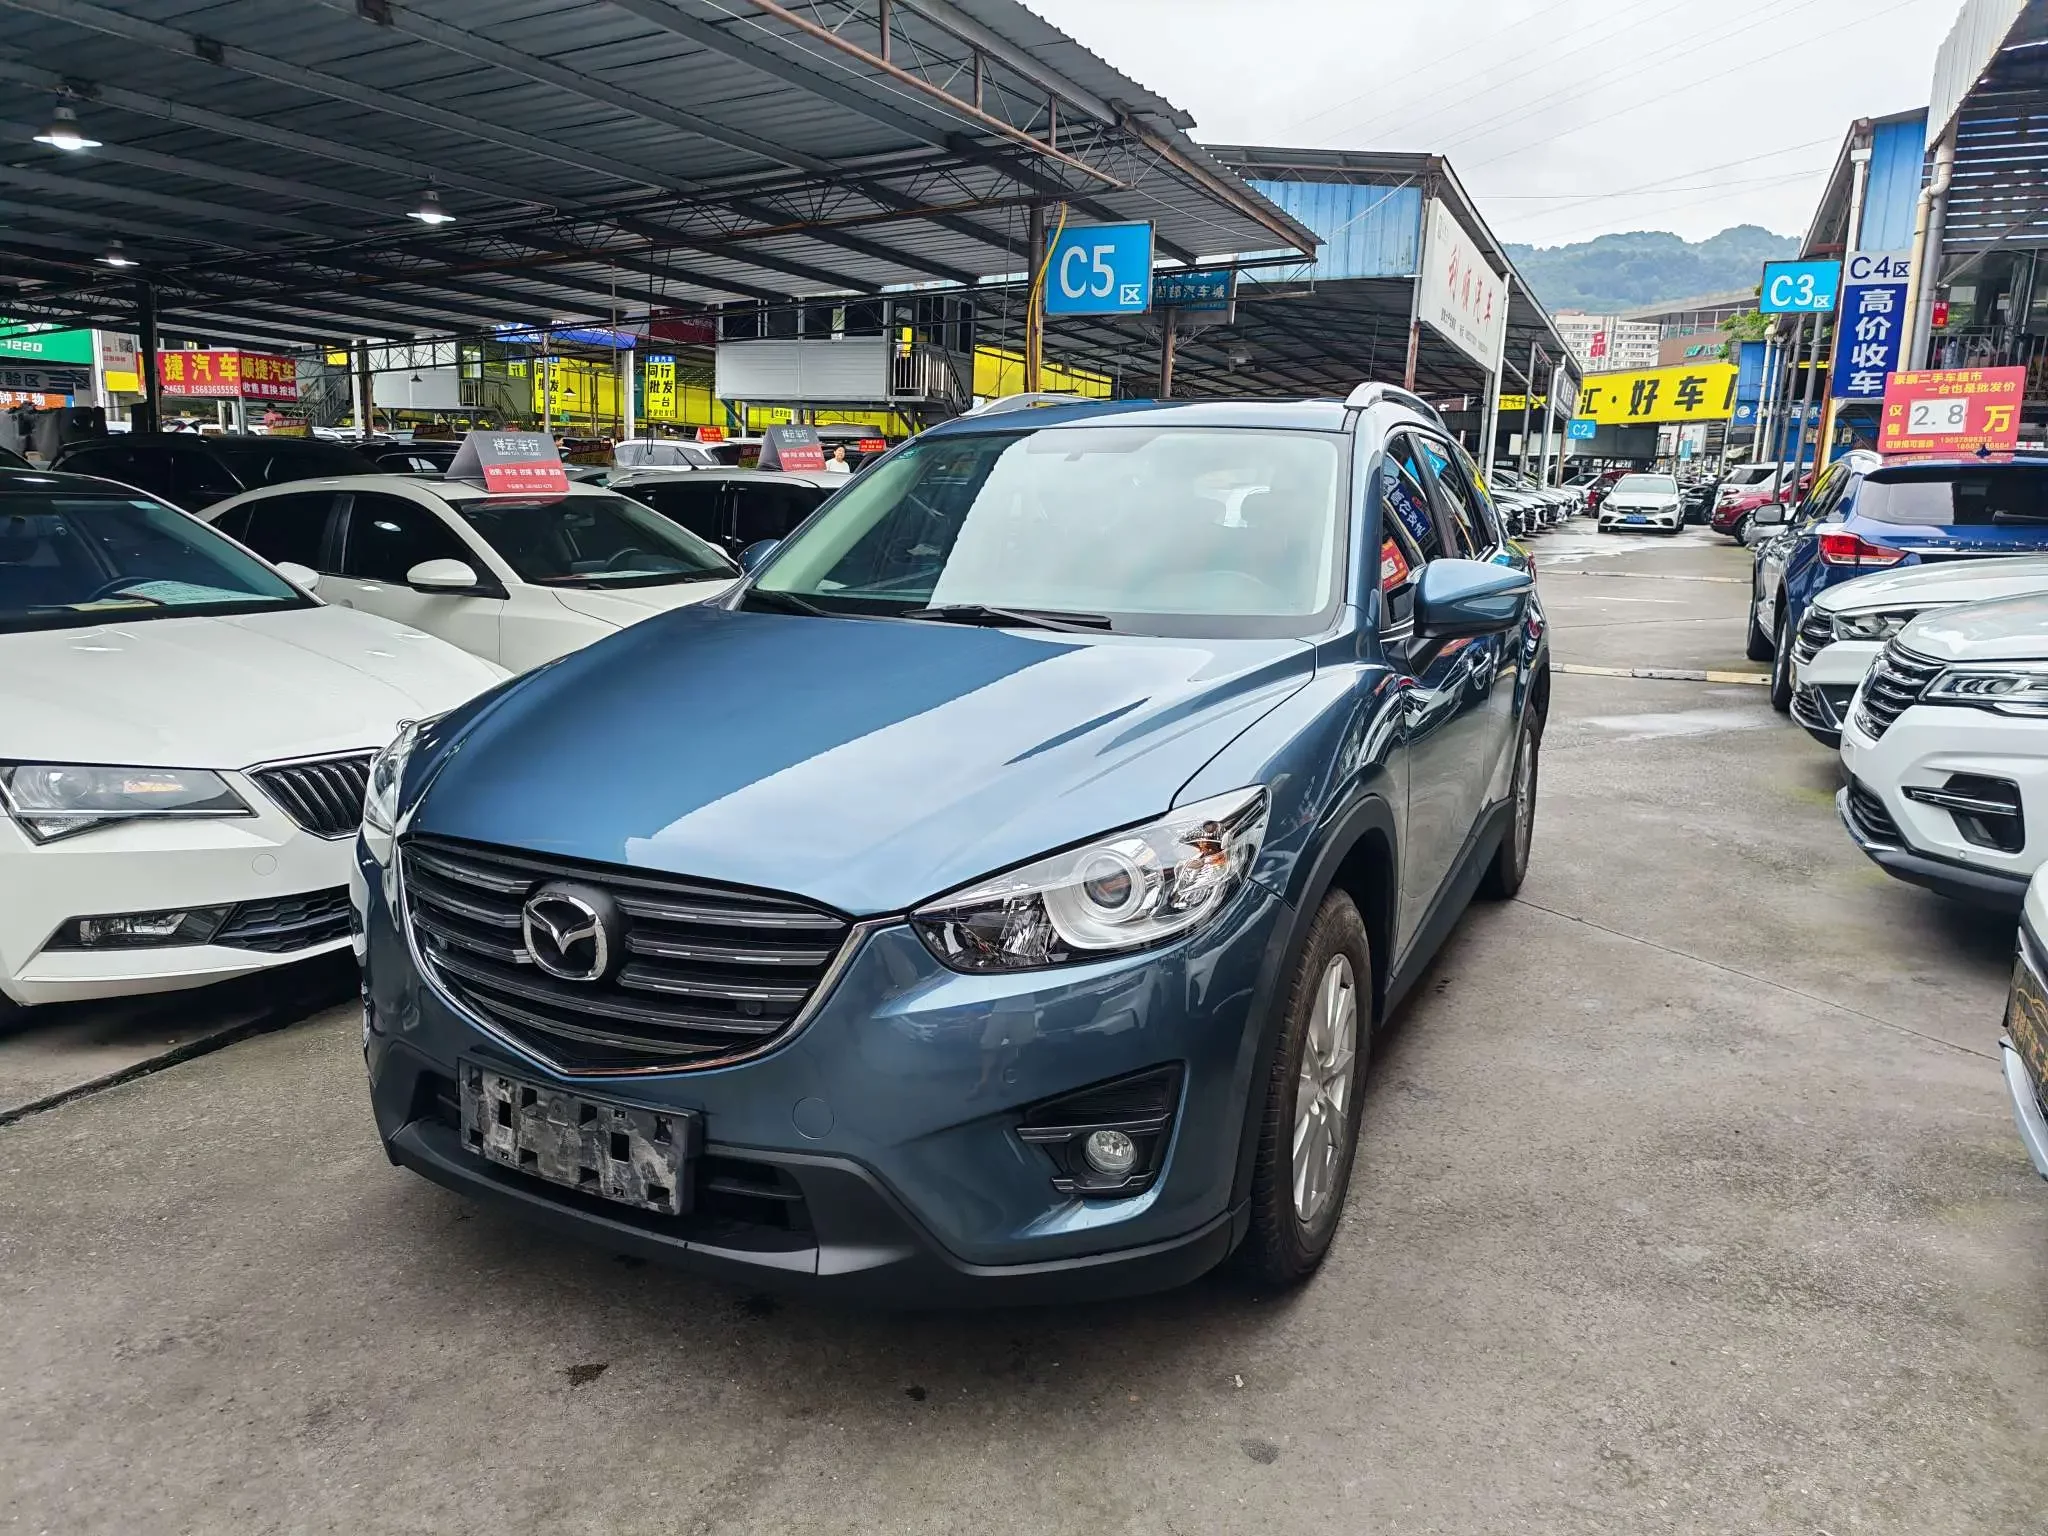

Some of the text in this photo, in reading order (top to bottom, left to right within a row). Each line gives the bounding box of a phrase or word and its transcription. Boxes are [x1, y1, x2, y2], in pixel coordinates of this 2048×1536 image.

[1060, 245, 1142, 305] C5区
[1850, 256, 1910, 279] C4区
[1769, 274, 1830, 308] C3区
[1848, 289, 1895, 395] 高价收车
[241, 356, 296, 383] 顺捷汽车
[649, 364, 672, 378] 同行
[649, 380, 673, 394] 批发
[1925, 381, 2016, 394] 一台也是批发价
[1982, 404, 2015, 433] 万
